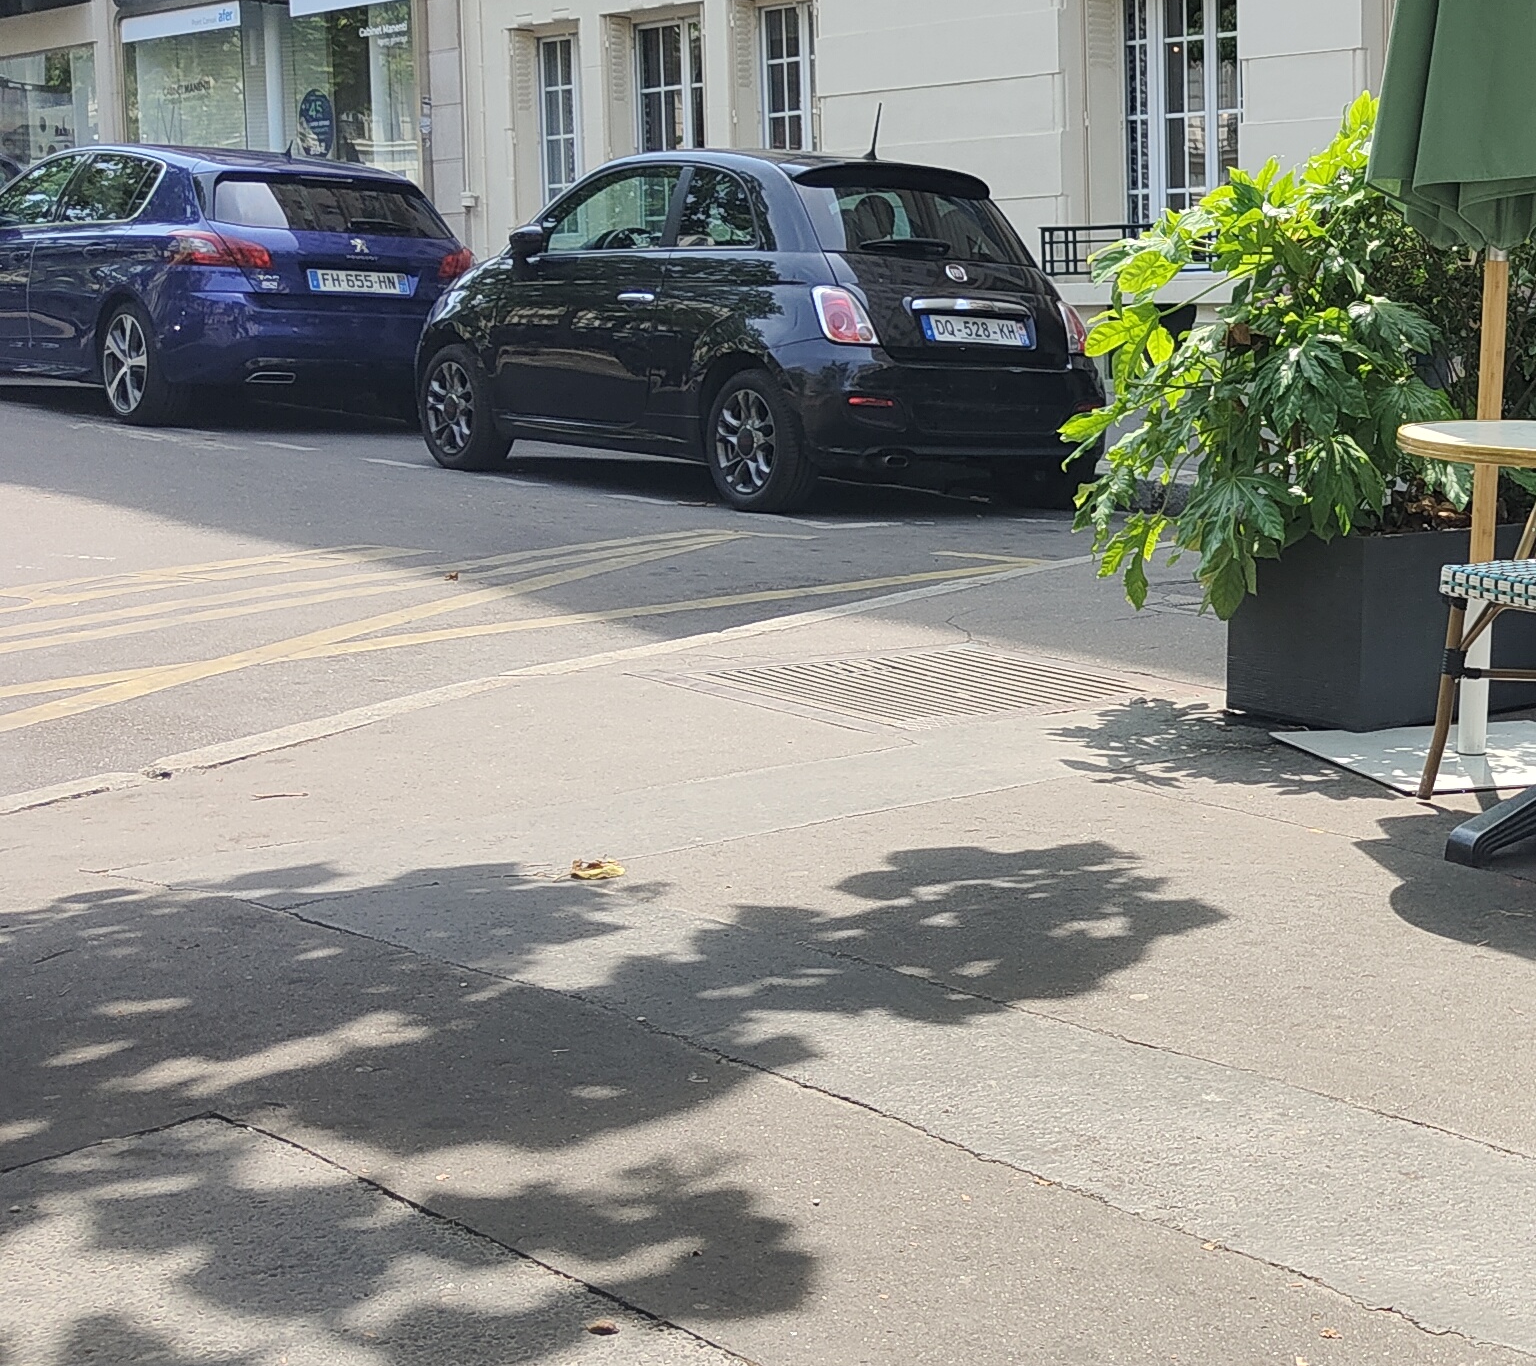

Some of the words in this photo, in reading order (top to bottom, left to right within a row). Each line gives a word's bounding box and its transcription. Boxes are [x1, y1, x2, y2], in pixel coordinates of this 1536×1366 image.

[218, 8, 234, 23] afer
[320, 272, 398, 291] FH-655-HN
[933, 318, 1018, 341] DQ-528-KH
